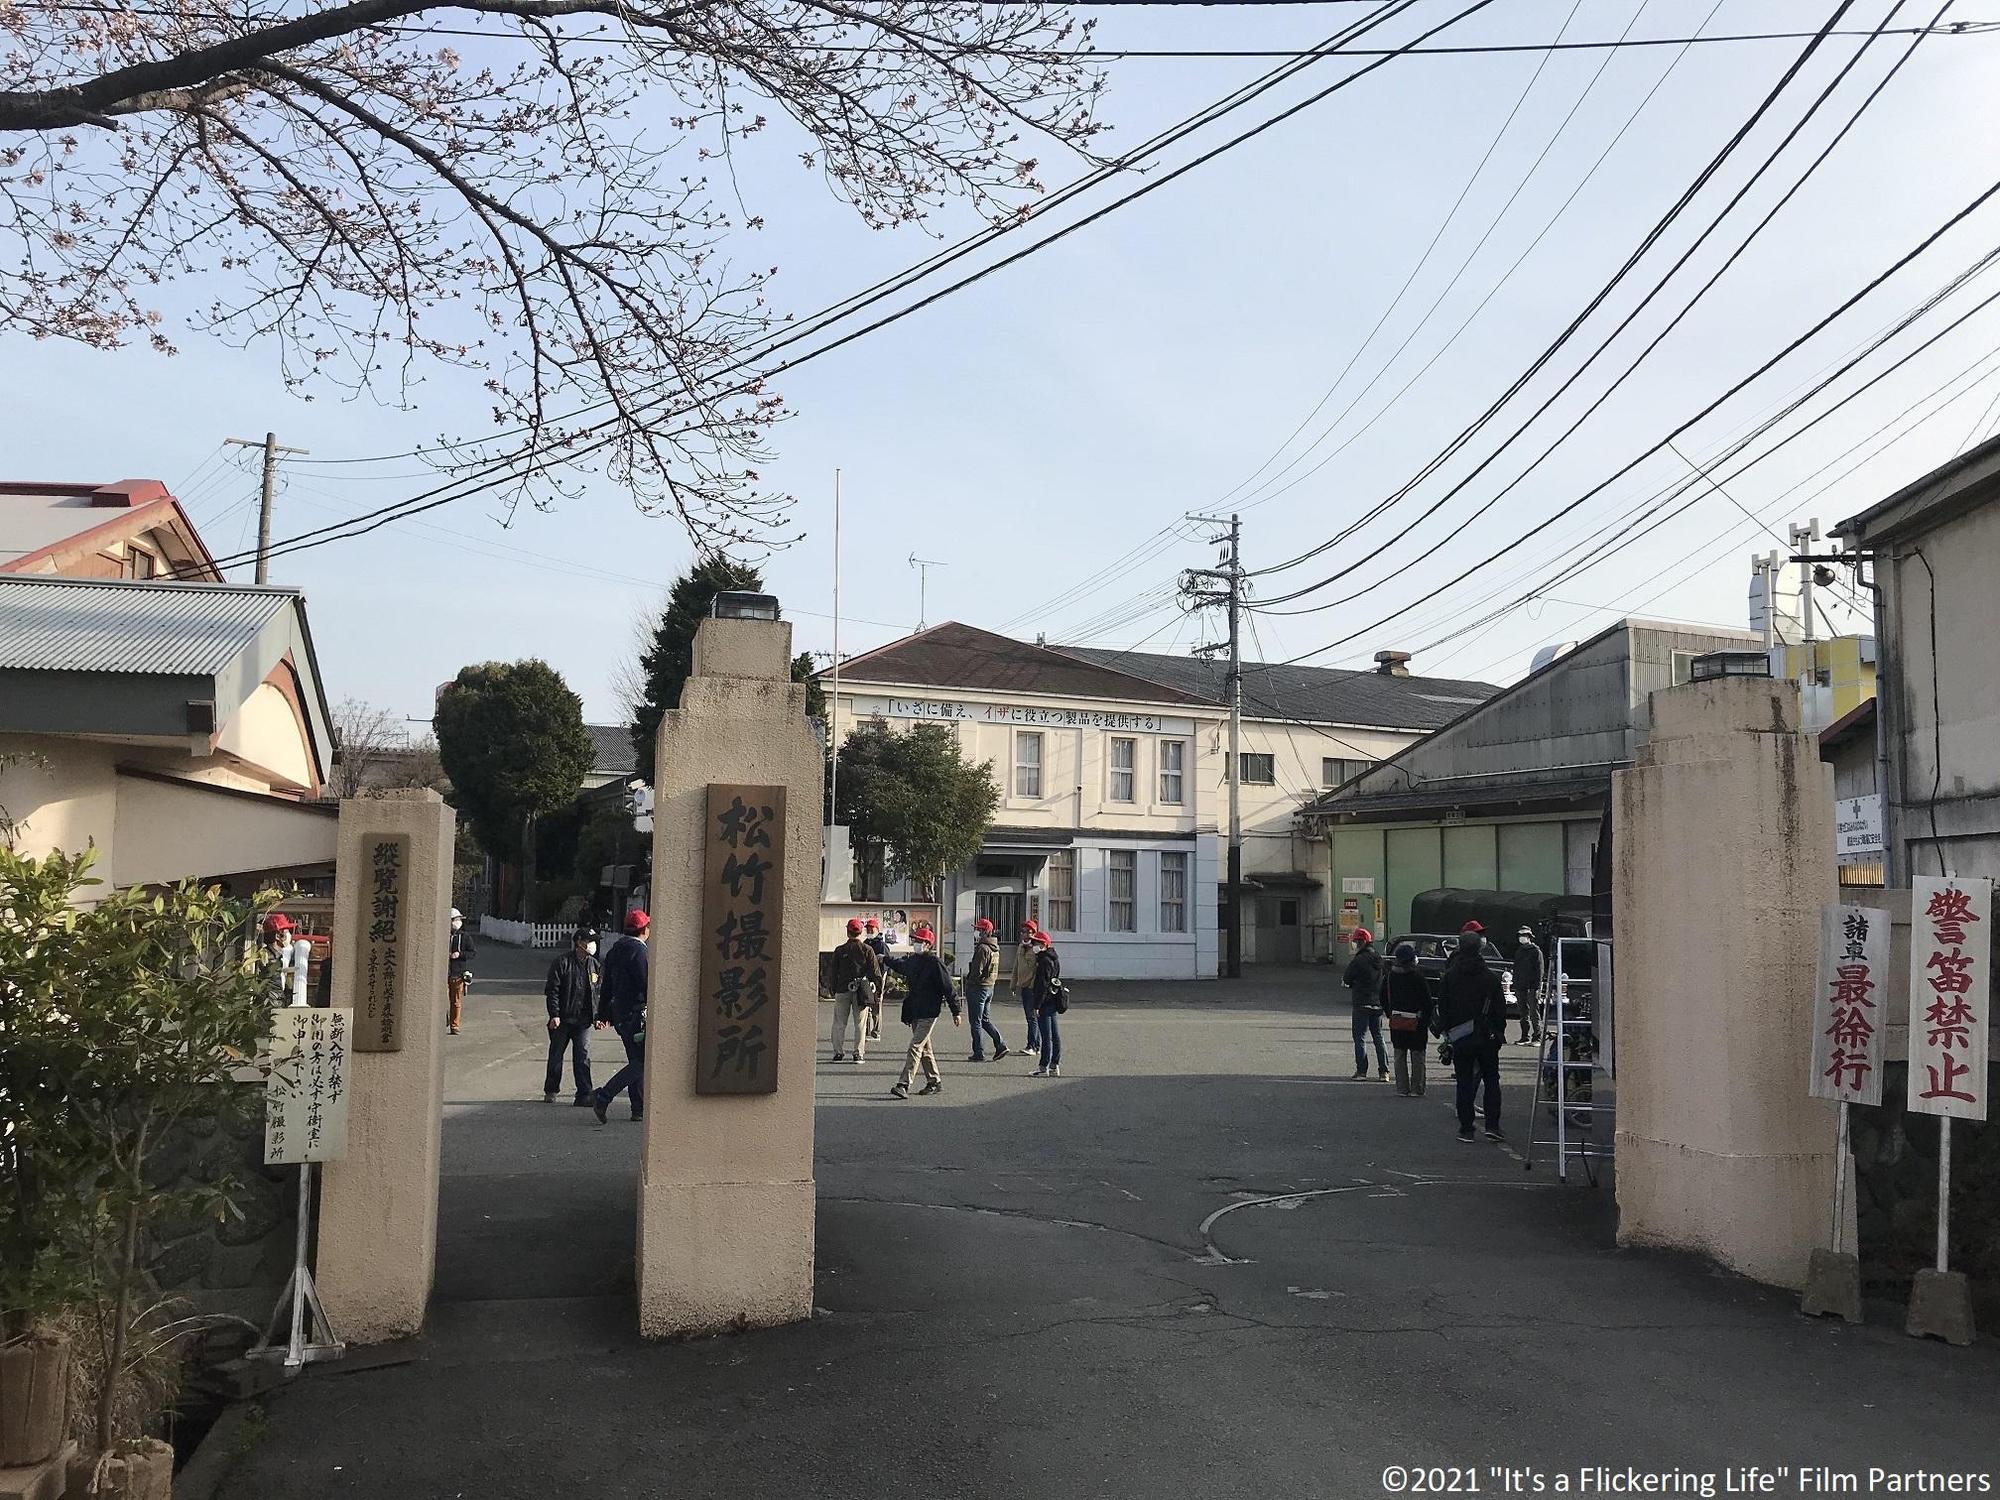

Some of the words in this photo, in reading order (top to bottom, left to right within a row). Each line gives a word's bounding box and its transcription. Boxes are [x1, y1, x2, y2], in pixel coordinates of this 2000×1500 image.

[711, 796, 774, 1080] 松竹撮影所
[1824, 914, 1877, 1091] 諸車最徐行
[1919, 888, 1981, 1103] 警笛禁止
